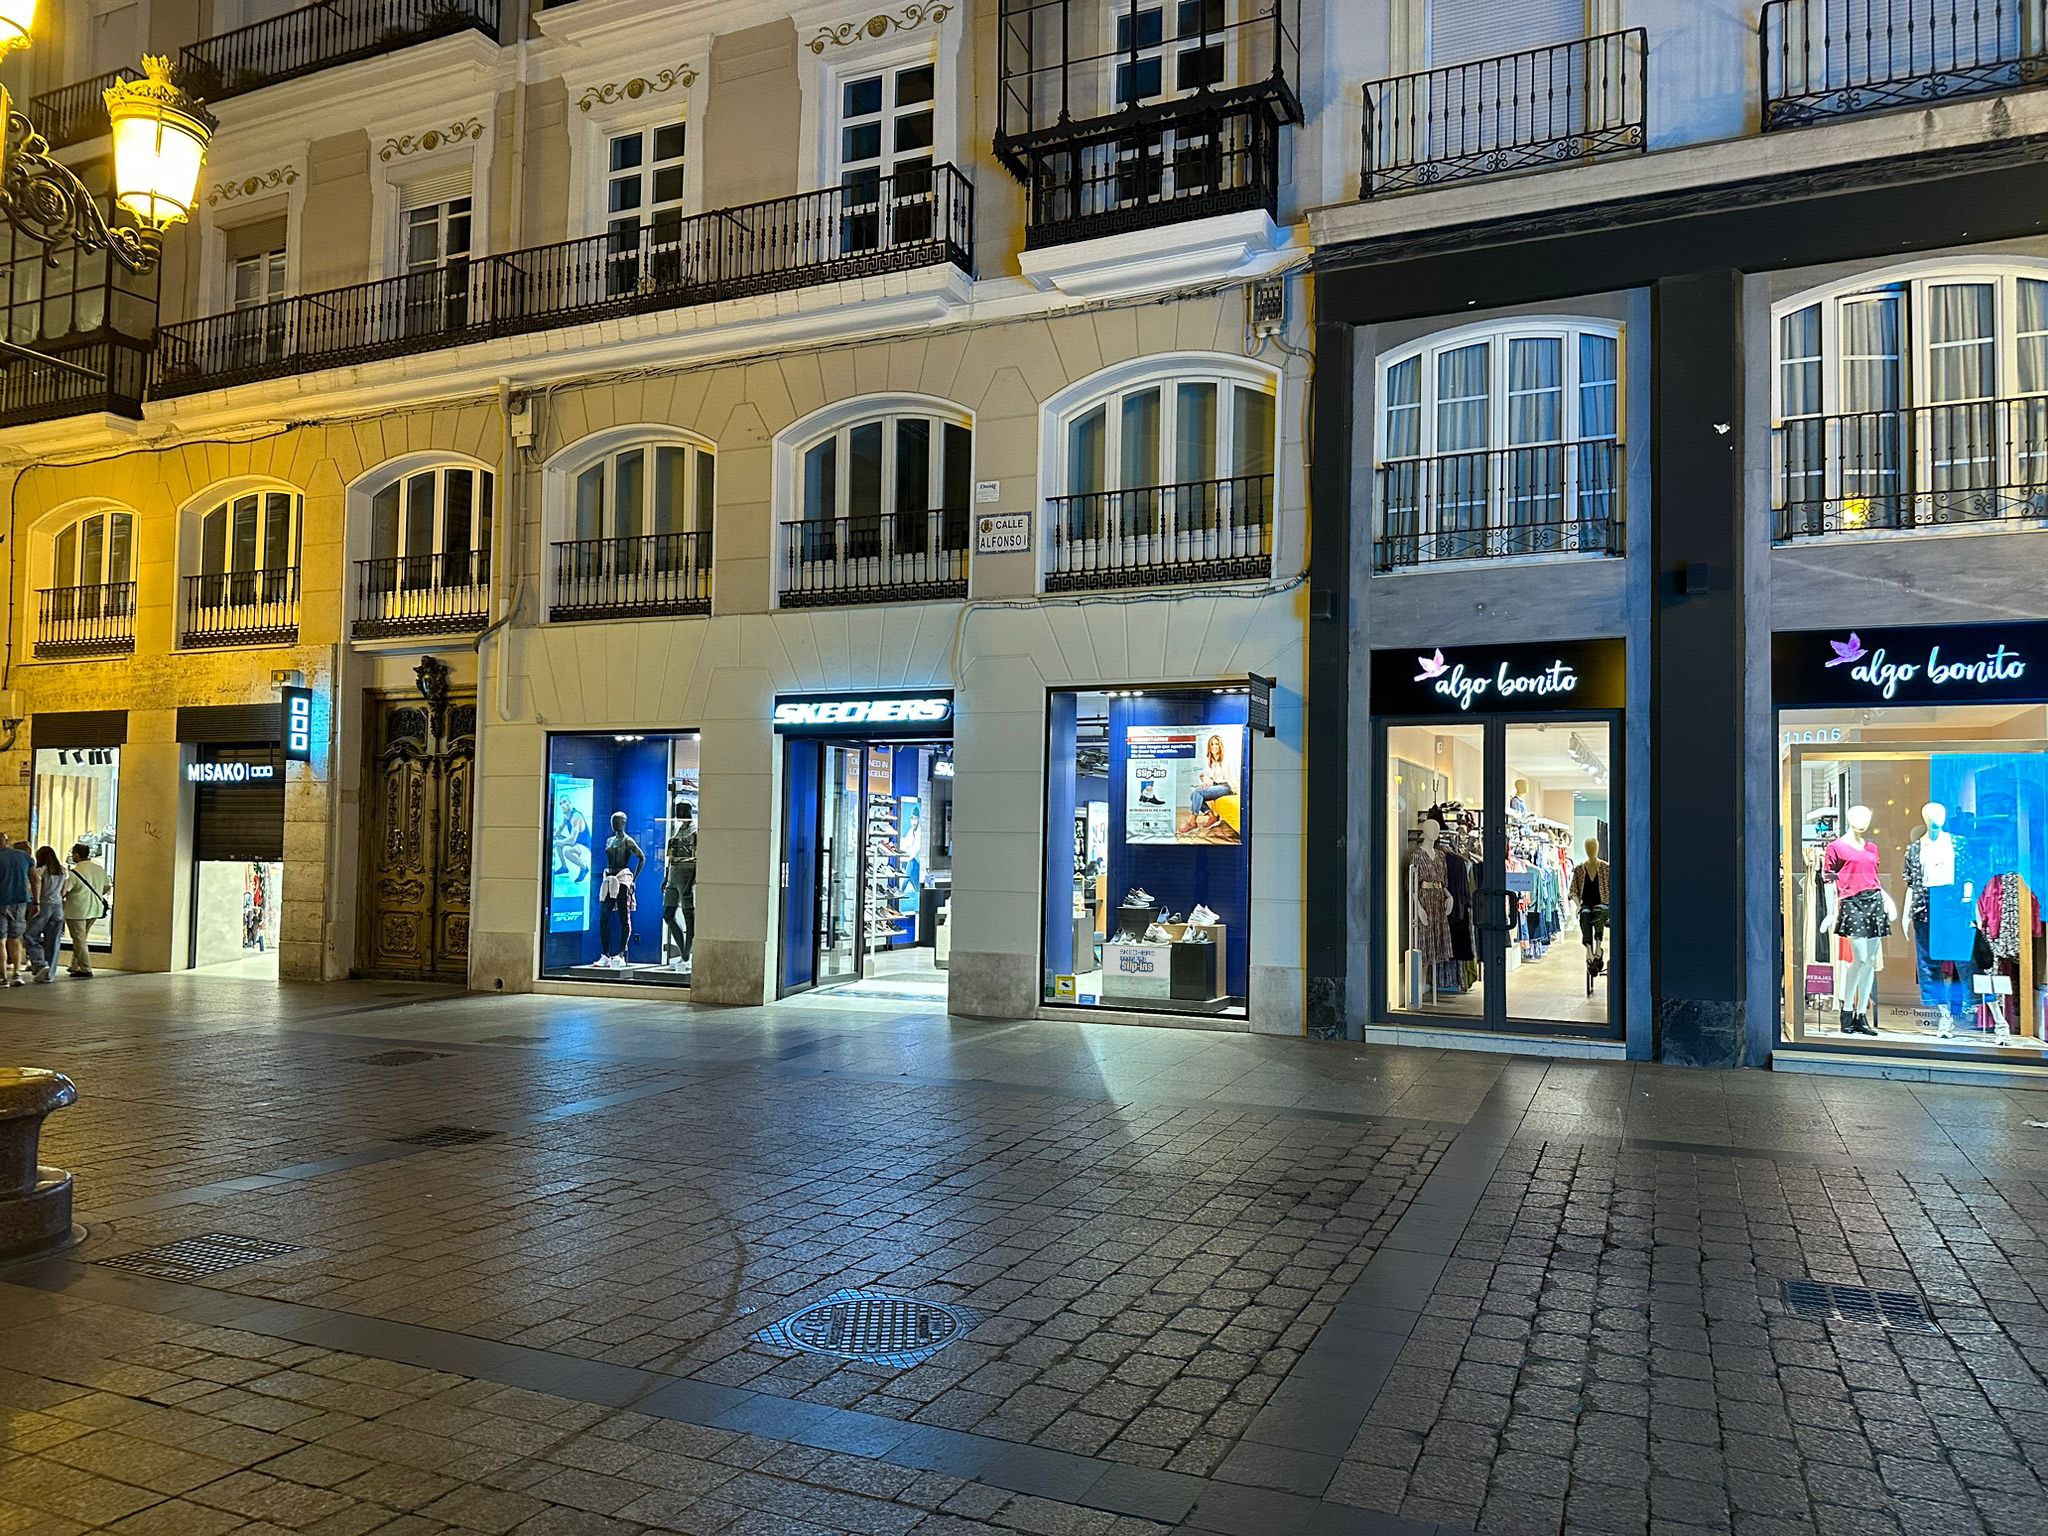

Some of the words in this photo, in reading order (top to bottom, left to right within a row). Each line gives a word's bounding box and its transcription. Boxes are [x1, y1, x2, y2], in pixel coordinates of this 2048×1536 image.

[996, 519, 1023, 529] CALLE
[980, 535, 1022, 548] ALFONSO
[1023, 535, 1027, 546] I
[1851, 648, 1921, 699] algo
[1927, 644, 2027, 684] bonito
[1435, 664, 1492, 710] algo
[1497, 660, 1578, 696] bonito
[773, 699, 952, 723] SKECHERS
[188, 763, 245, 781] MISAKO
[1120, 959, 1154, 973] Slip-ins
